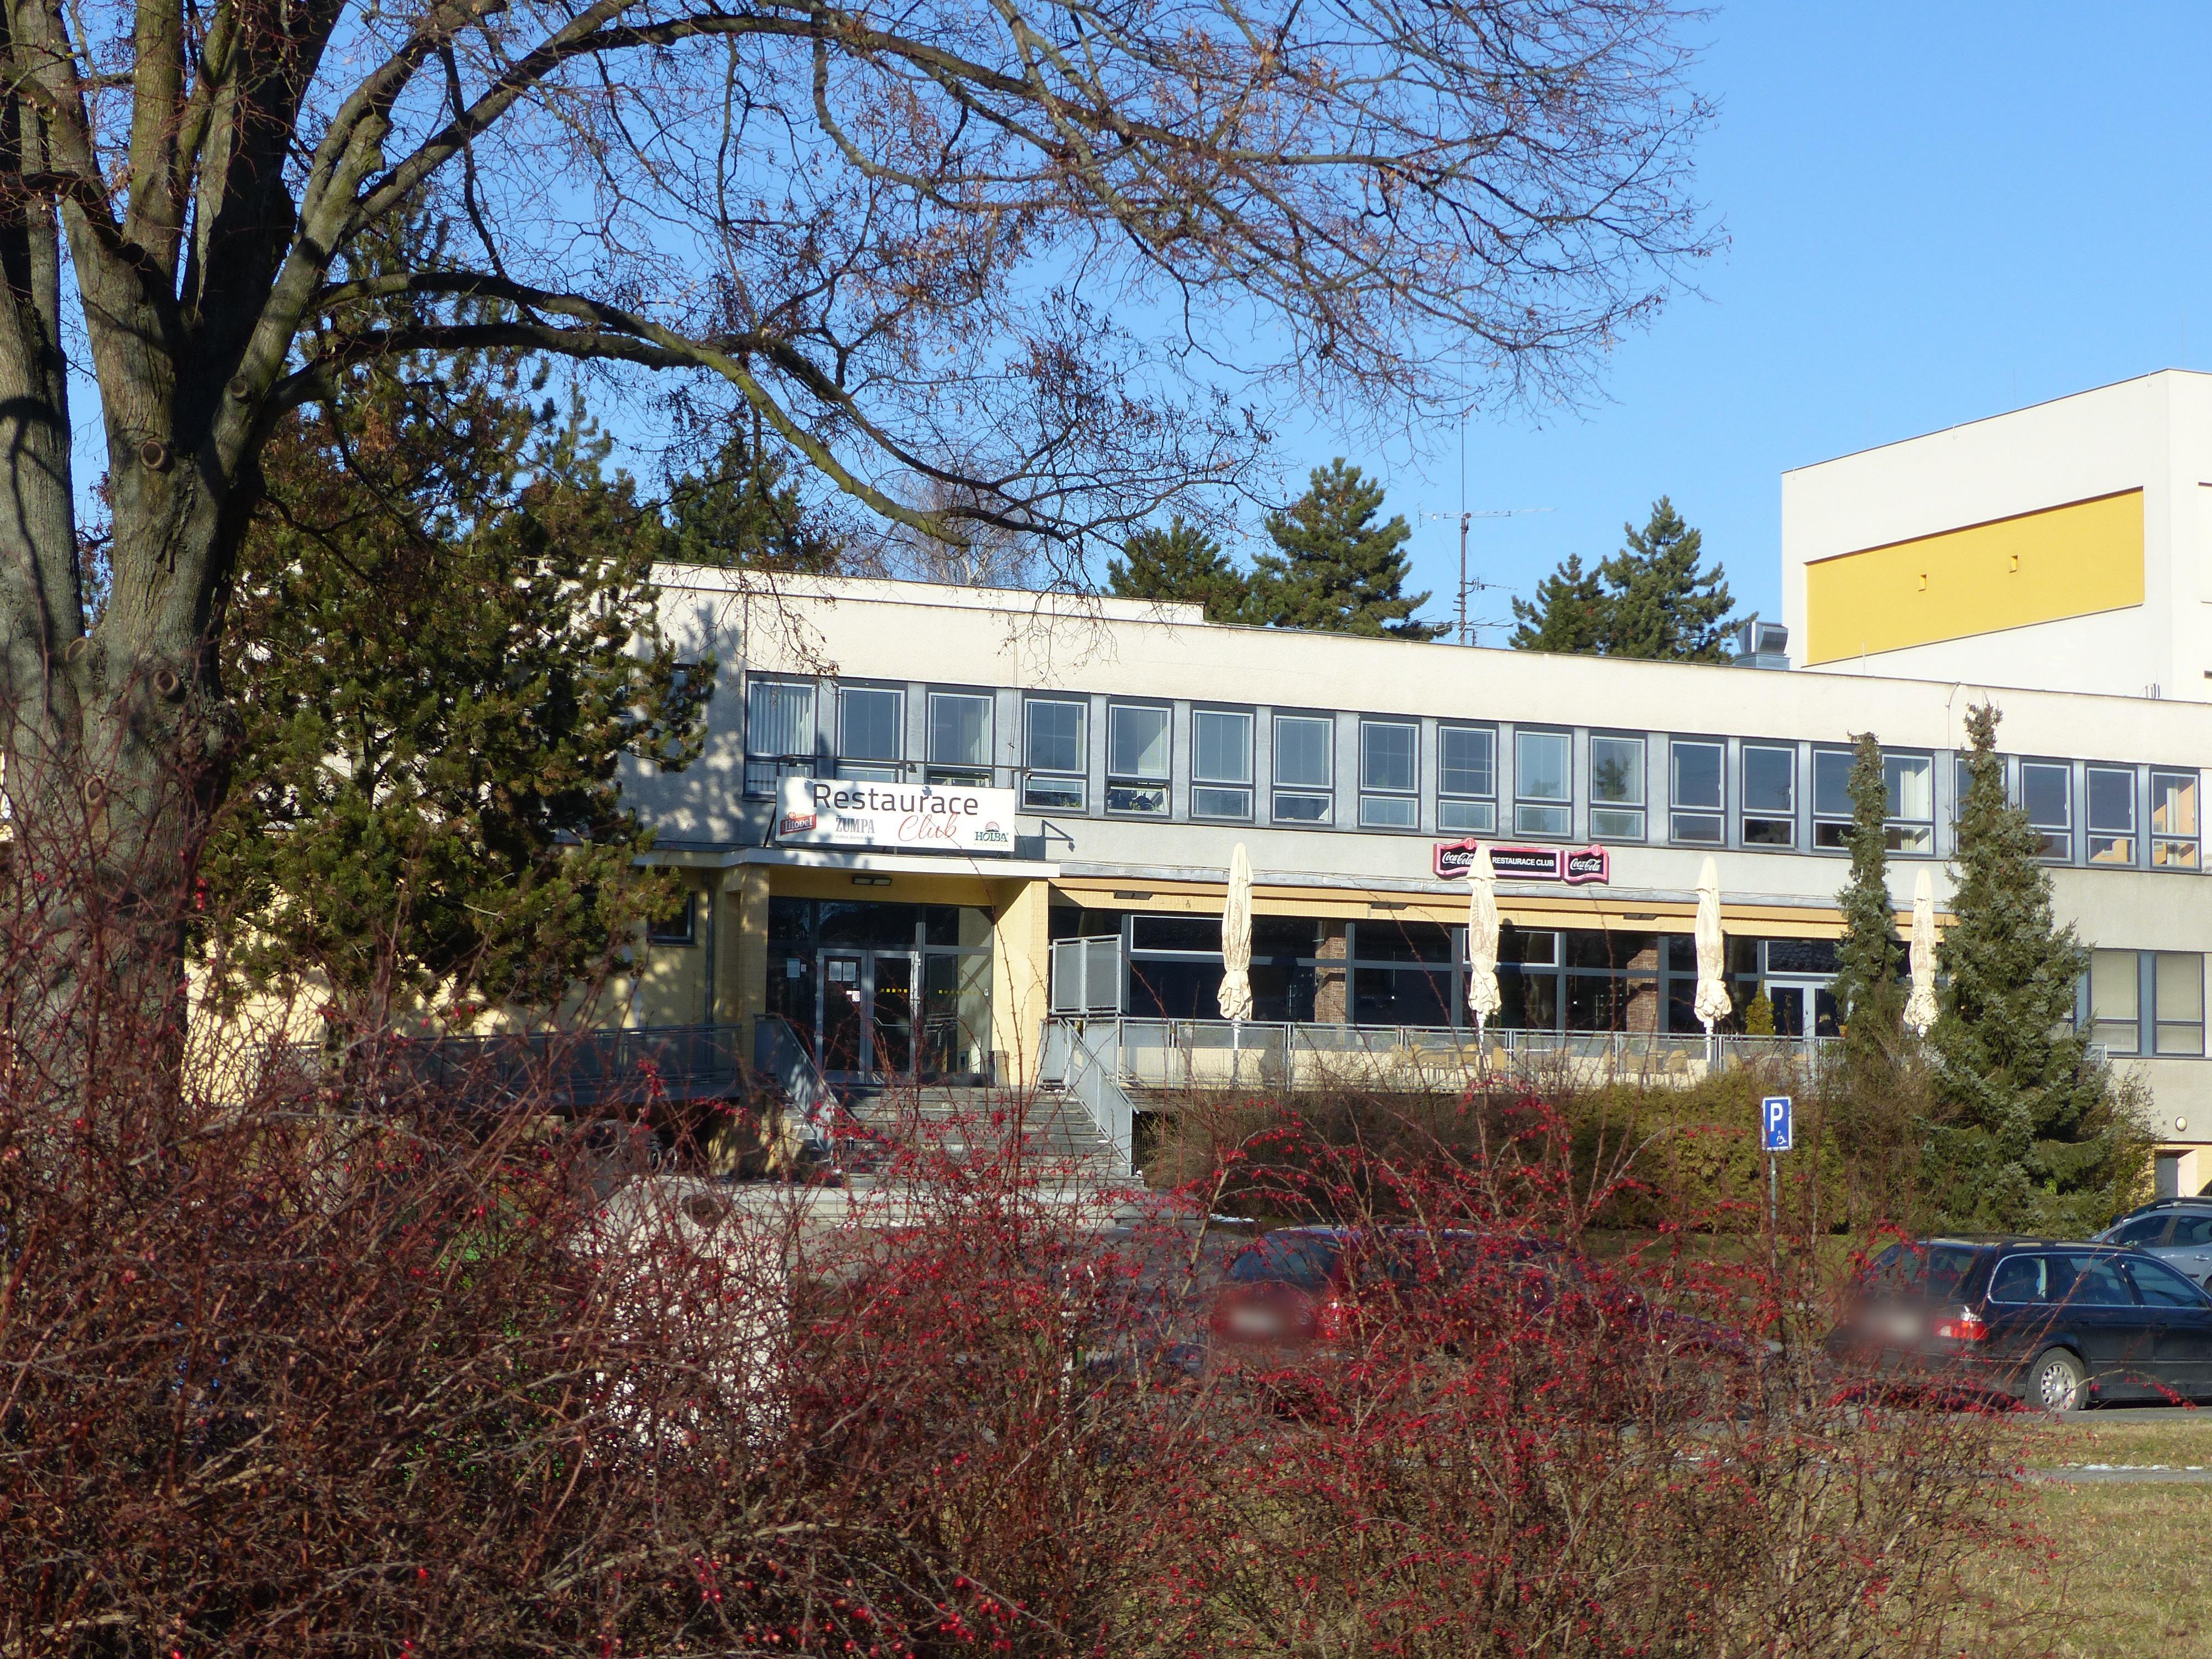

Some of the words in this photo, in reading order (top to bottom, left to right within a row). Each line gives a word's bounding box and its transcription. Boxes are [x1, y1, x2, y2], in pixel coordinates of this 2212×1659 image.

[813, 783, 978, 815] Restaurace
[785, 816, 812, 832] Litovel
[836, 815, 875, 833] ŽUMPA
[898, 812, 957, 841] Club
[975, 832, 1008, 842] HOLBA
[1492, 857, 1535, 866] RESTAURACE
[1770, 1103, 1783, 1132] P
